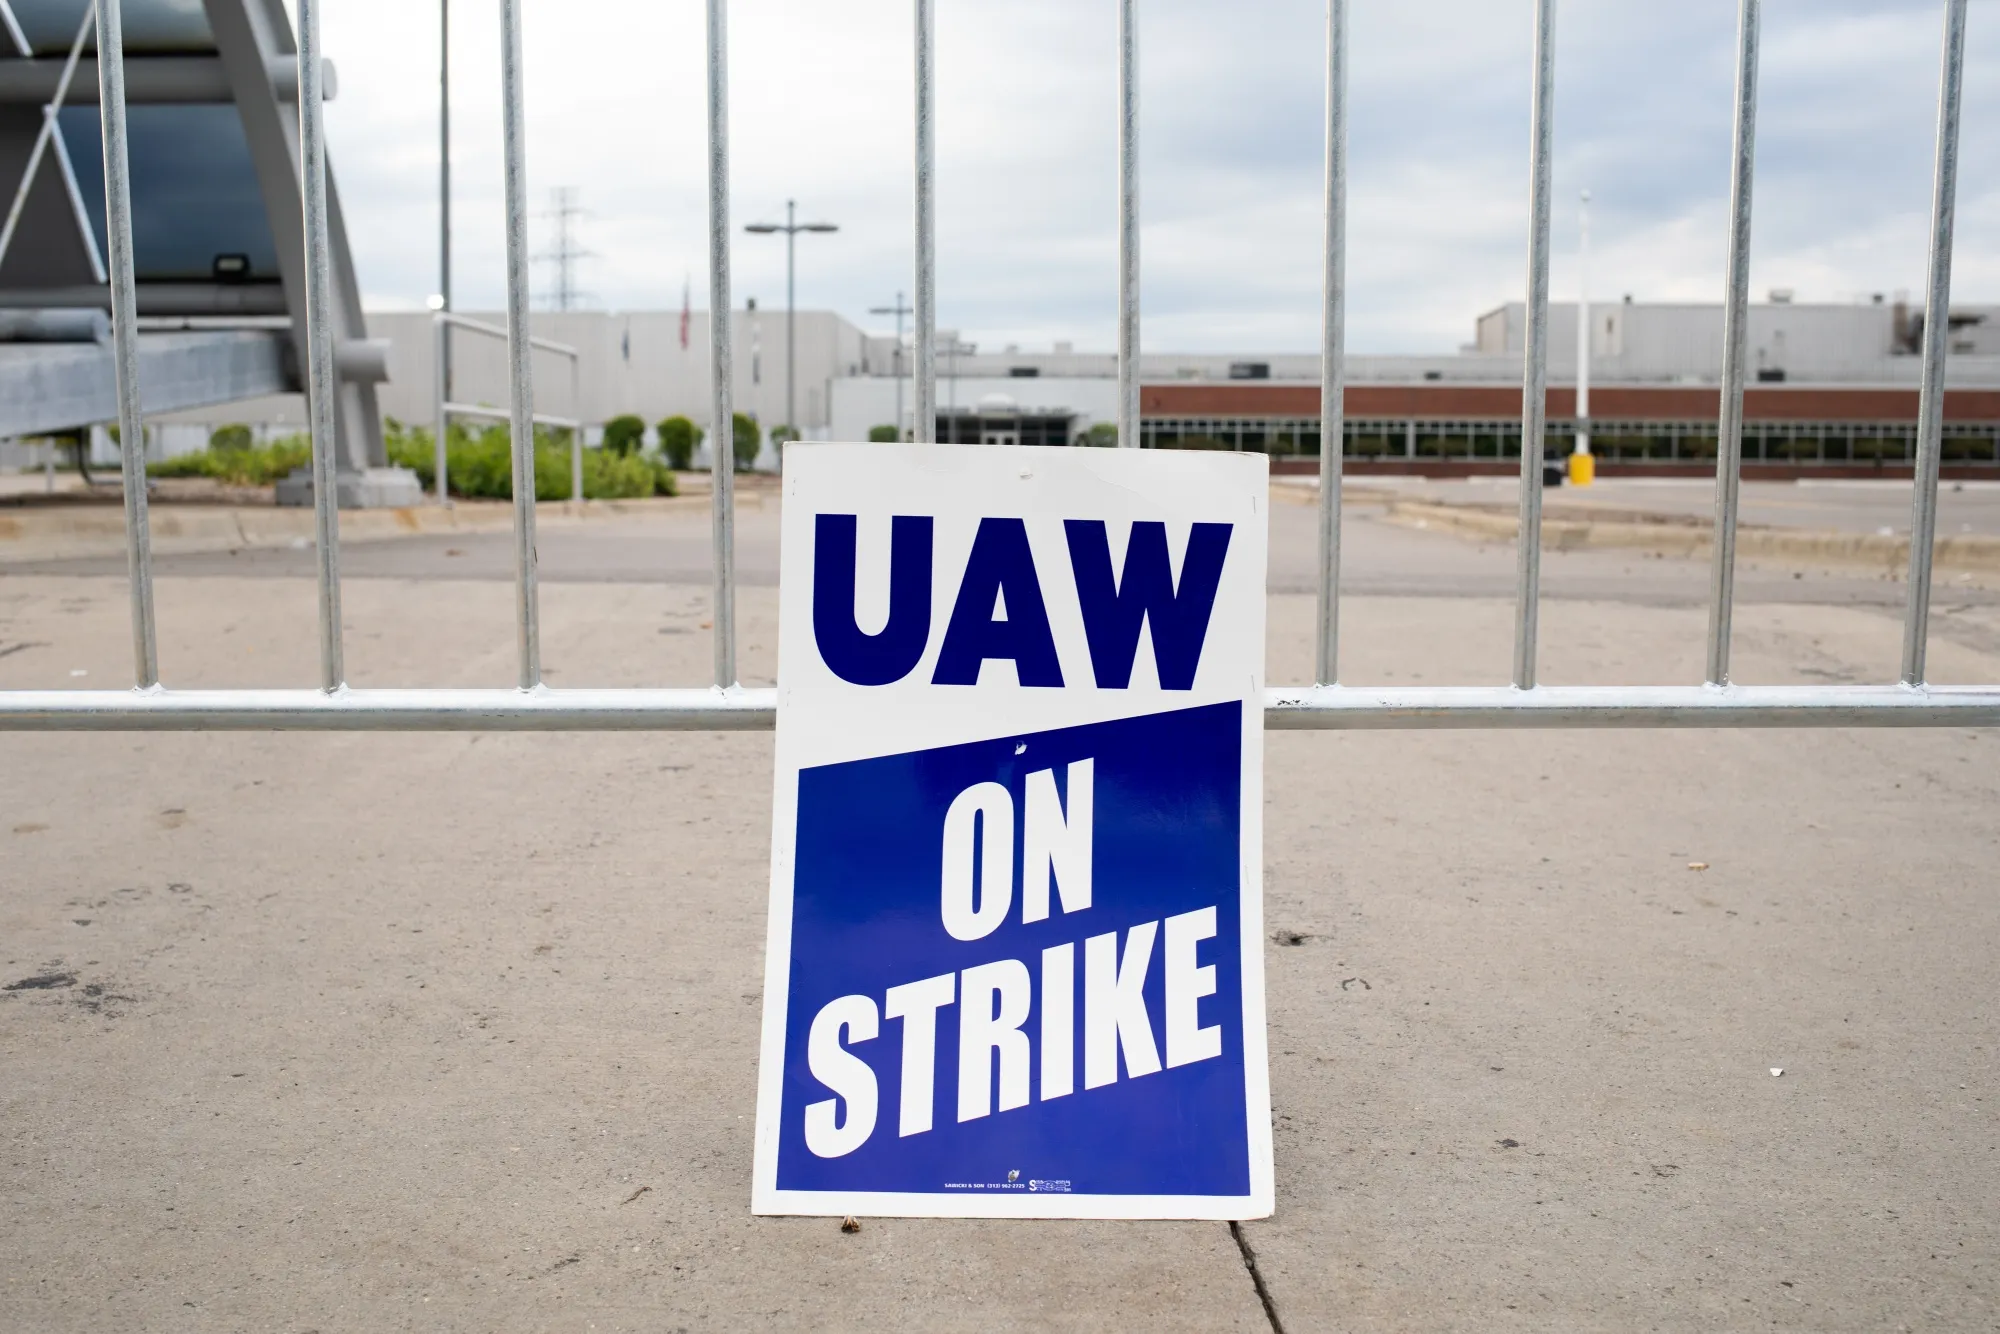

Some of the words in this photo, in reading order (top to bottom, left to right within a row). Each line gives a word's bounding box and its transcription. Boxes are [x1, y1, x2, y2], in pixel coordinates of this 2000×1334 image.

[813, 514, 1233, 690] UAW
[942, 758, 1093, 941] ON
[805, 906, 1221, 1158] STRIKE
